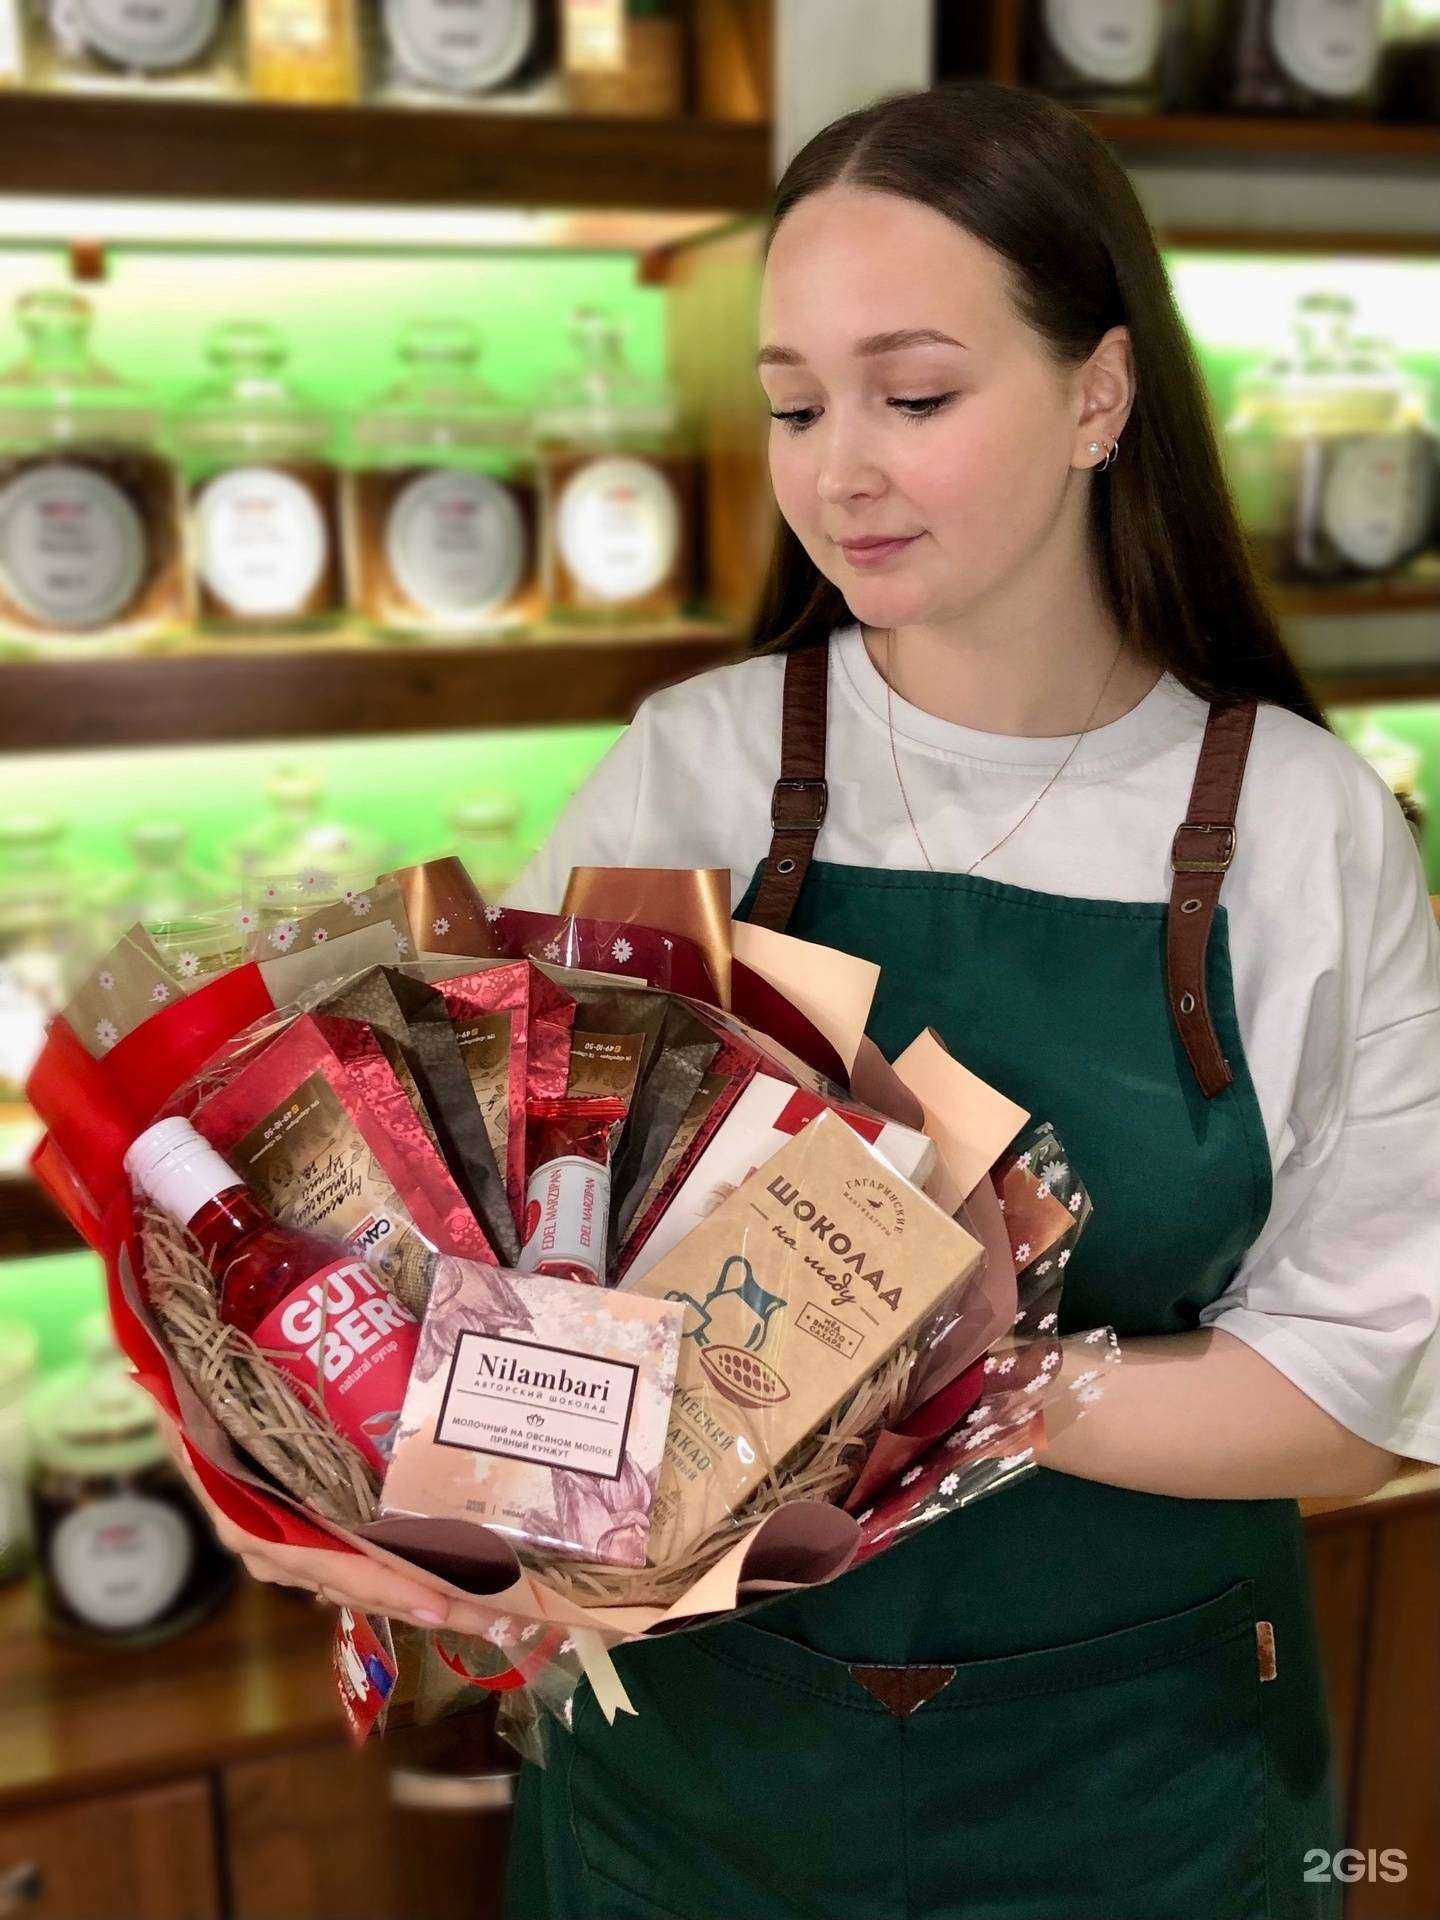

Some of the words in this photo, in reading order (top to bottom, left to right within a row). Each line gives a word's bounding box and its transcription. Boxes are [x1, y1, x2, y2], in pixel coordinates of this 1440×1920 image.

[545, 1169, 562, 1221] MARZIPAN
[582, 1177, 595, 1220] MARZIPAN
[542, 1222, 557, 1250] EDEL
[580, 1222, 592, 1248] EDEL
[766, 1175, 903, 1311] ШОКОЛАД
[772, 1225, 798, 1251] на
[804, 1256, 856, 1306] меду
[809, 1325, 842, 1350] САХАРА
[812, 1319, 846, 1344] ВМЕСТО
[337, 1358, 373, 1395] natural
[370, 1340, 399, 1364] syrup
[476, 1352, 611, 1401] Nilambari
[474, 1379, 543, 1400] АВТОРСКИЙ
[549, 1395, 607, 1414] ШОКОЛАД
[452, 1416, 508, 1435] МОЛОЧНЫЙ
[510, 1428, 523, 1438] НА
[526, 1431, 572, 1448] ОВСЯНОМ
[575, 1442, 614, 1457] МОЛОКЕ
[490, 1434, 530, 1450] ПРЯНЫЙ
[531, 1444, 569, 1458] КУНЖУТ
[667, 1420, 712, 1471] АКАО
